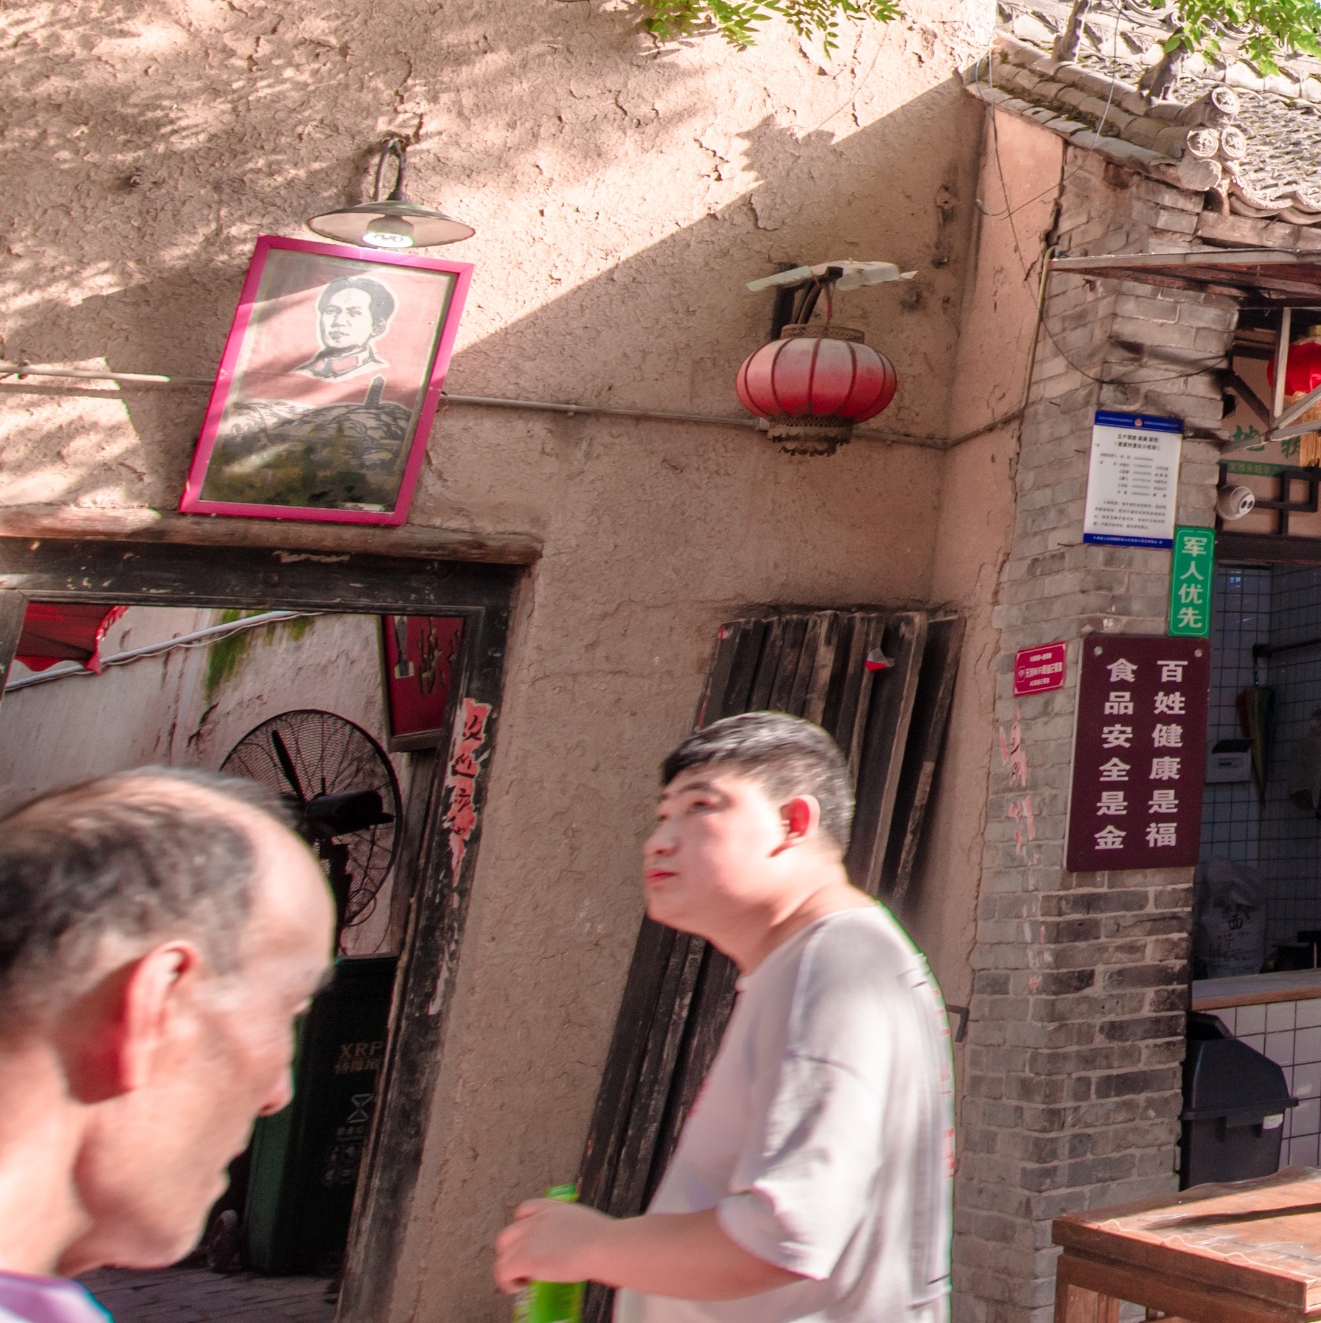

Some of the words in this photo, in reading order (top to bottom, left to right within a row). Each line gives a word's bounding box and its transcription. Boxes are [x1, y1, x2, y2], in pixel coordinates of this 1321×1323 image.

[1177, 536, 1208, 628] 军人优先
[1094, 658, 1138, 850] 食品安全是金
[1146, 660, 1188, 847] 百姓健康是福
